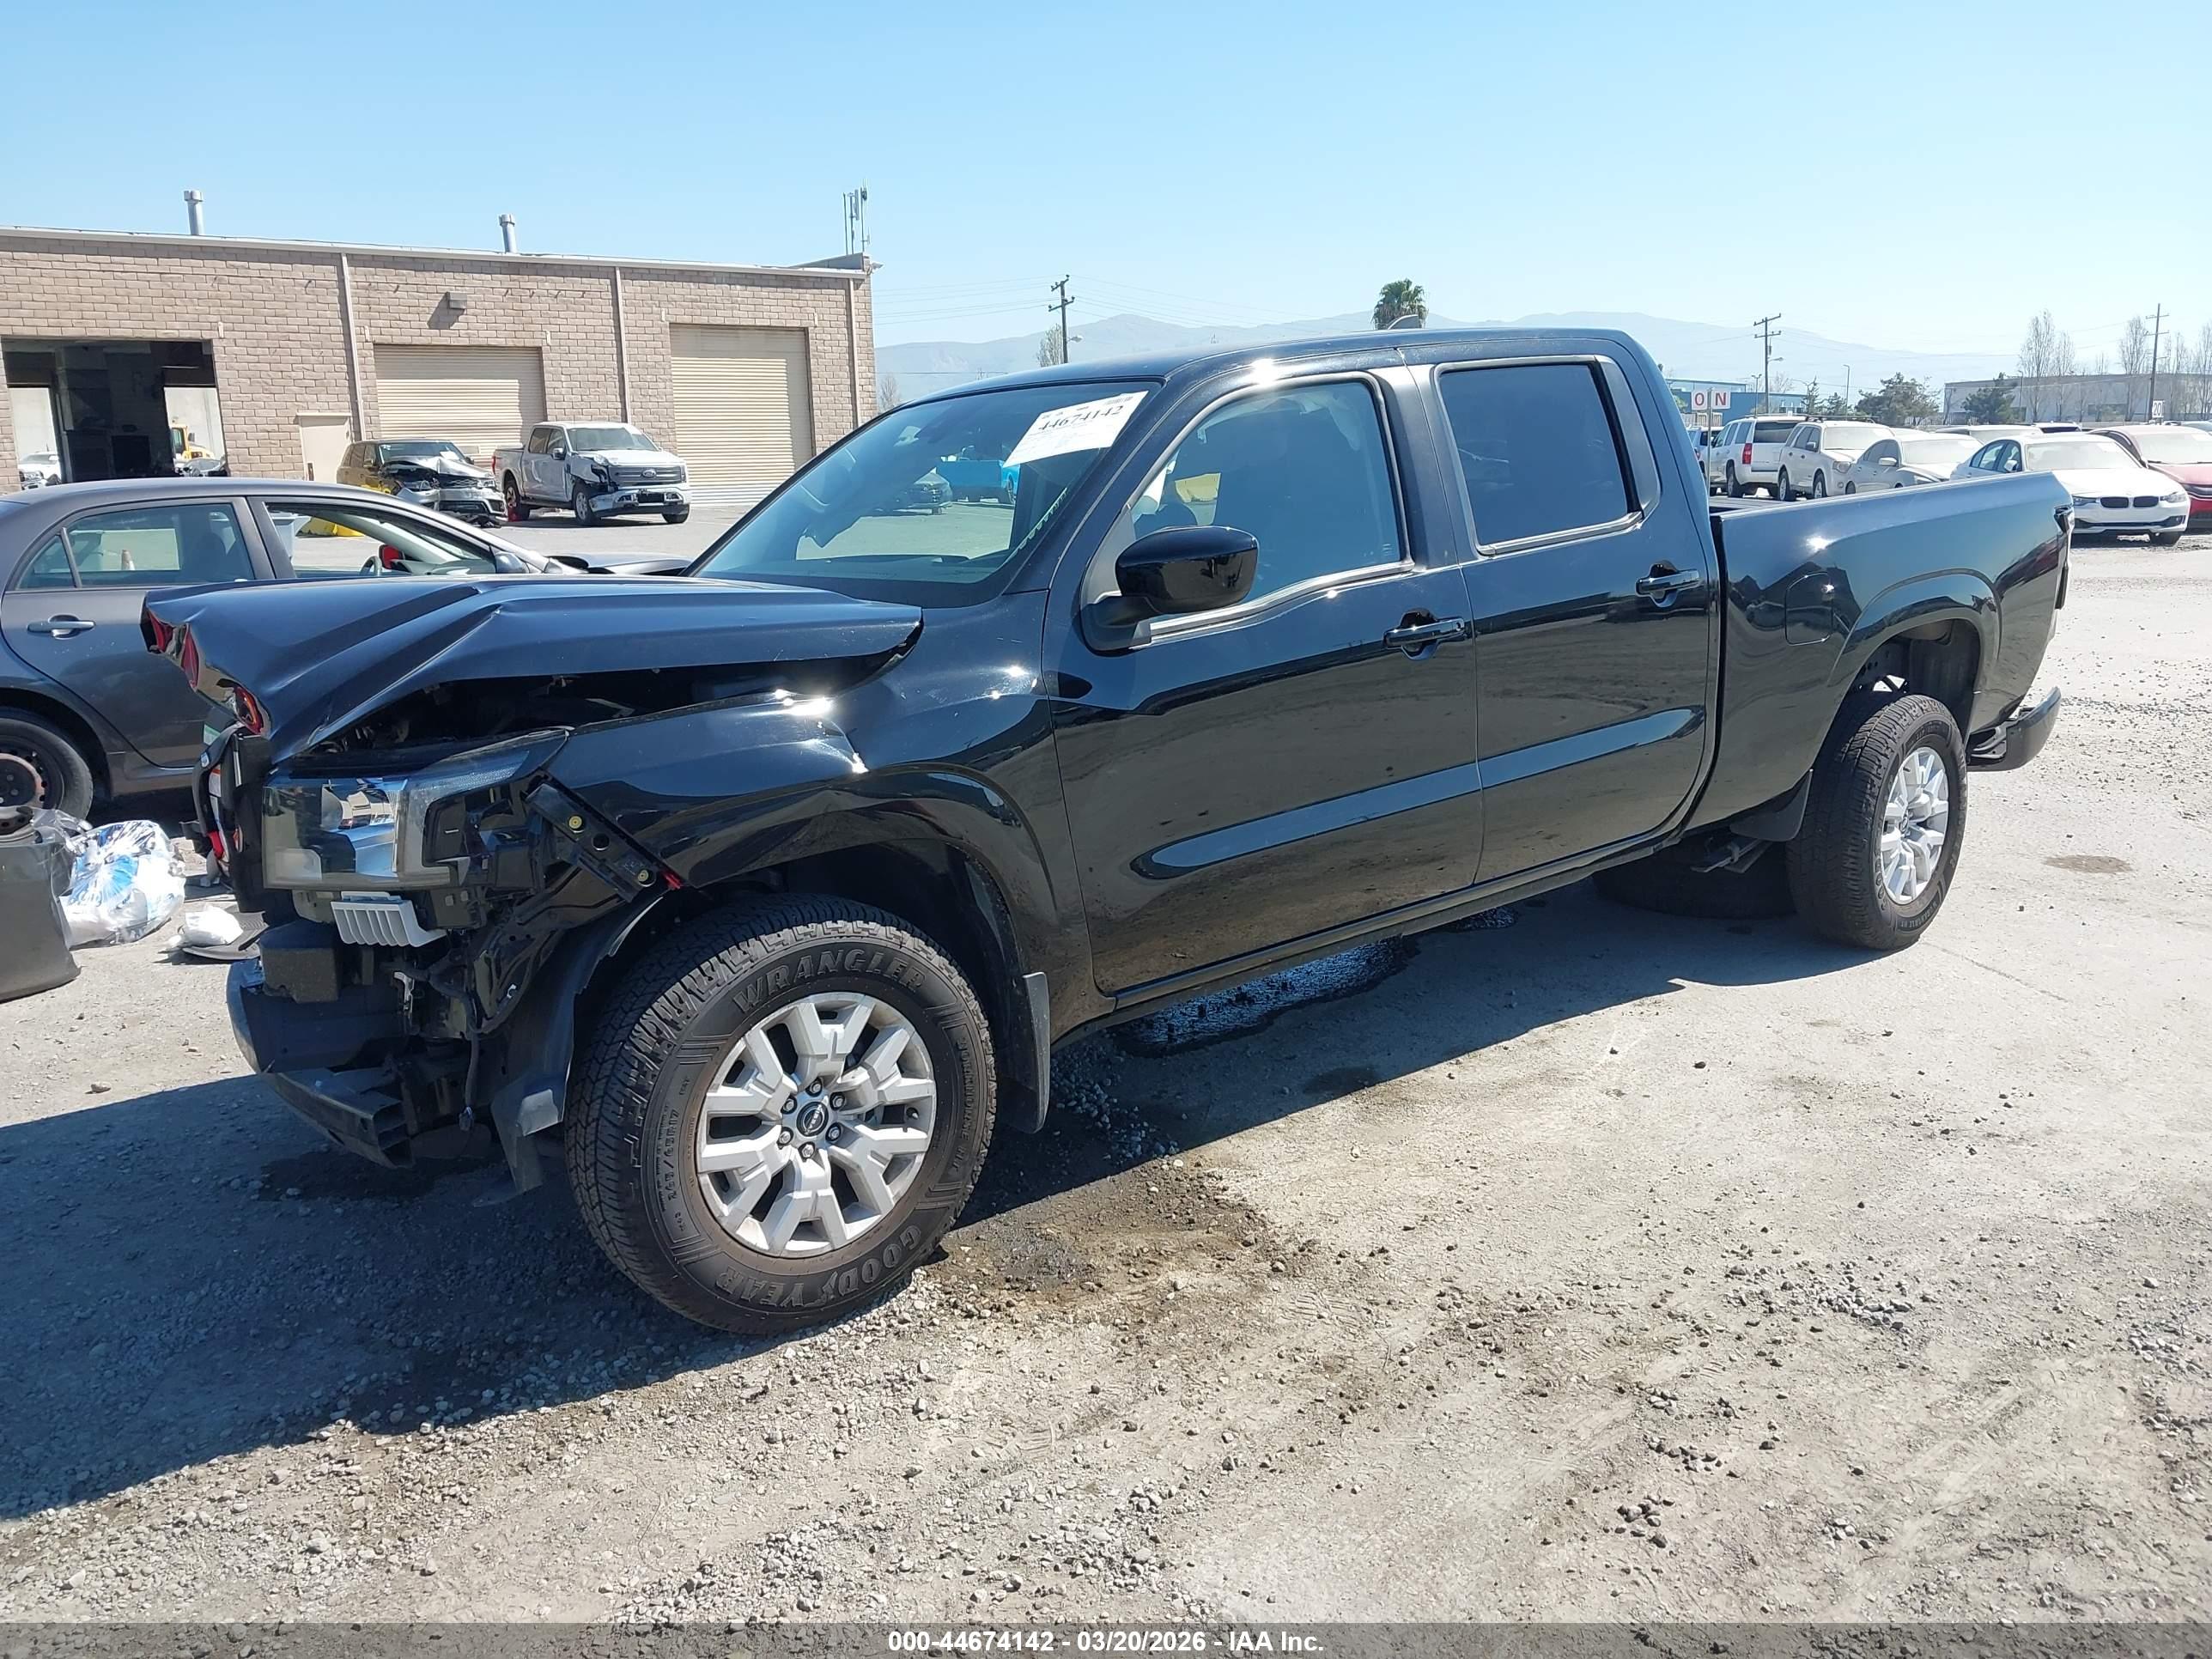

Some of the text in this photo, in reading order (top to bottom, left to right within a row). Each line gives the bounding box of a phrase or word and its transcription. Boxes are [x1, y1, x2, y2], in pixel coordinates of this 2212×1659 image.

[1715, 392, 1727, 406] N
[2153, 402, 2162, 416] 20
[1038, 405, 1124, 431] 44674142
[733, 949, 927, 1013] WRANGLER
